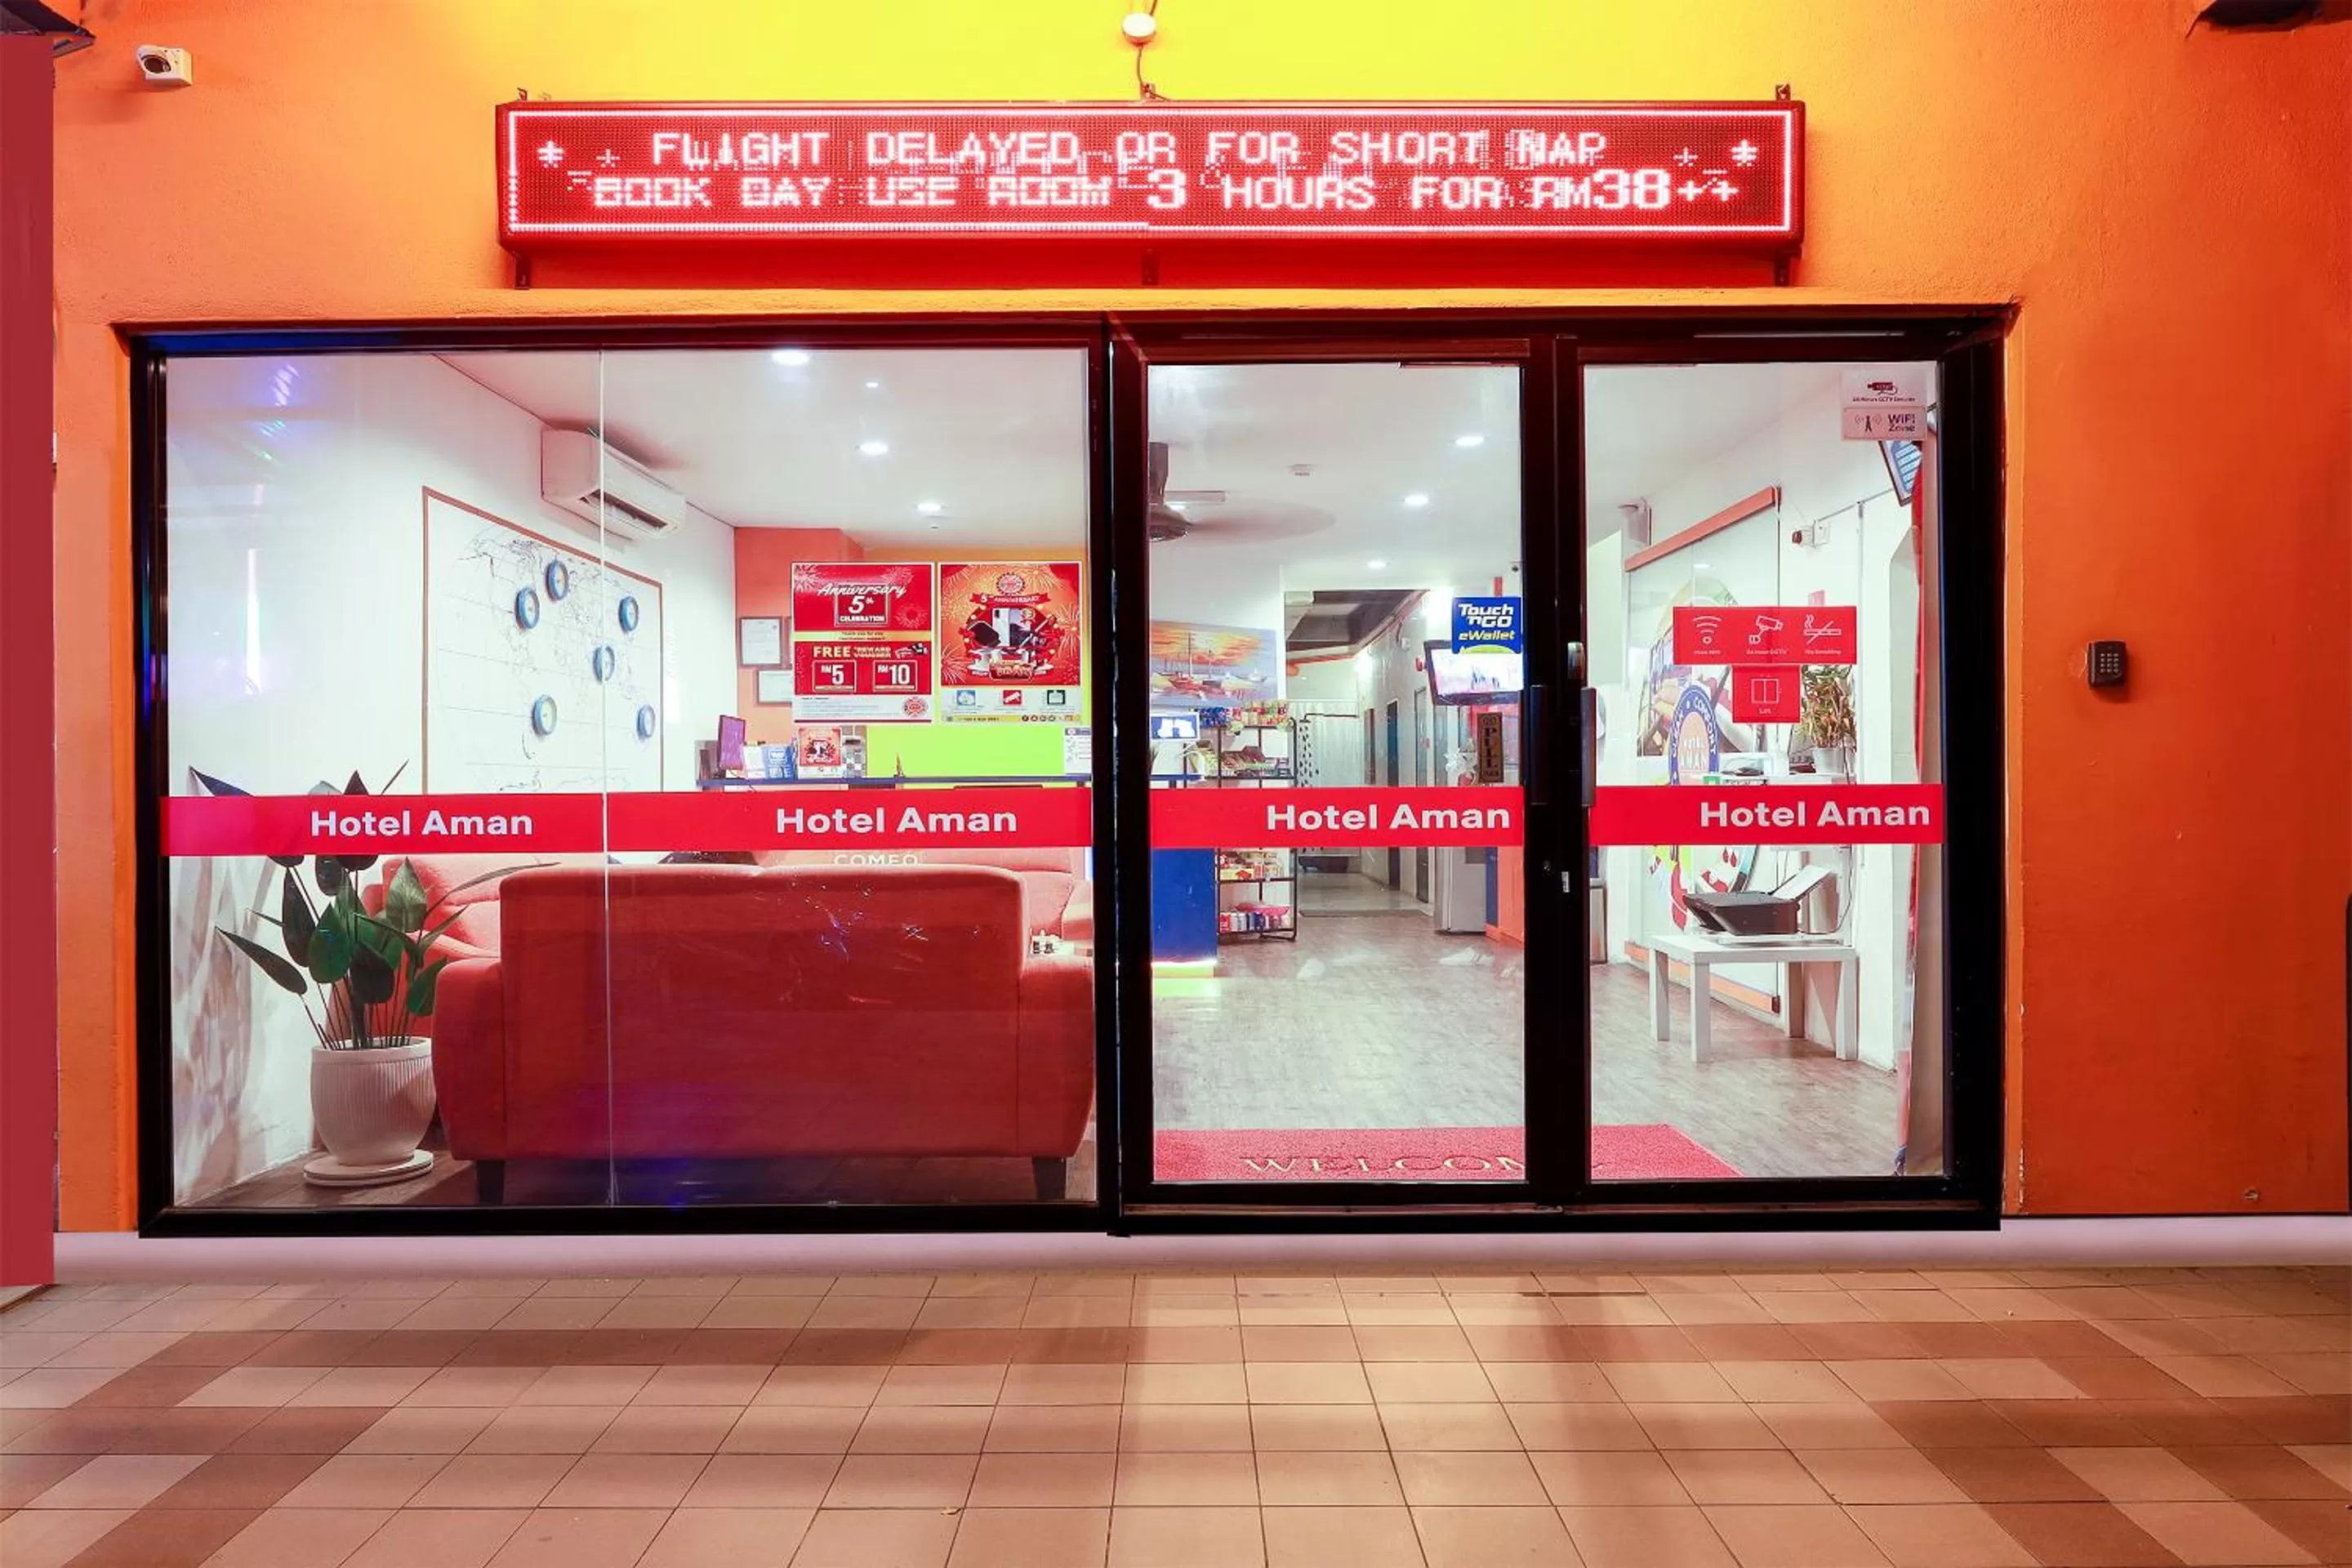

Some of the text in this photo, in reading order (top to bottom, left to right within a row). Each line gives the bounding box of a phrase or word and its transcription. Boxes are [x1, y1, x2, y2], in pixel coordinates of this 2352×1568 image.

[866, 131, 1080, 165] DELAYED
[1116, 131, 1176, 165] OR
[1206, 131, 1298, 166] FOR
[1330, 131, 1488, 166] SHORT
[594, 176, 713, 208] BOOK
[866, 175, 959, 207] USE
[987, 175, 1111, 207] ROOM
[1147, 168, 1187, 209] 3
[1223, 174, 1376, 210] HOURS
[1410, 175, 1503, 210] FOR
[1888, 424, 1915, 432] Zone
[817, 582, 906, 599] Anniversary
[1458, 603, 1514, 617] Touch
[1458, 630, 1515, 640] eWallet
[813, 646, 851, 658] FREE
[311, 810, 532, 836] Hotel Aman
[777, 807, 1017, 833] Hotel Aman
[1267, 804, 1510, 830] Hotel Aman
[1700, 800, 1930, 827] Hotel Aman
